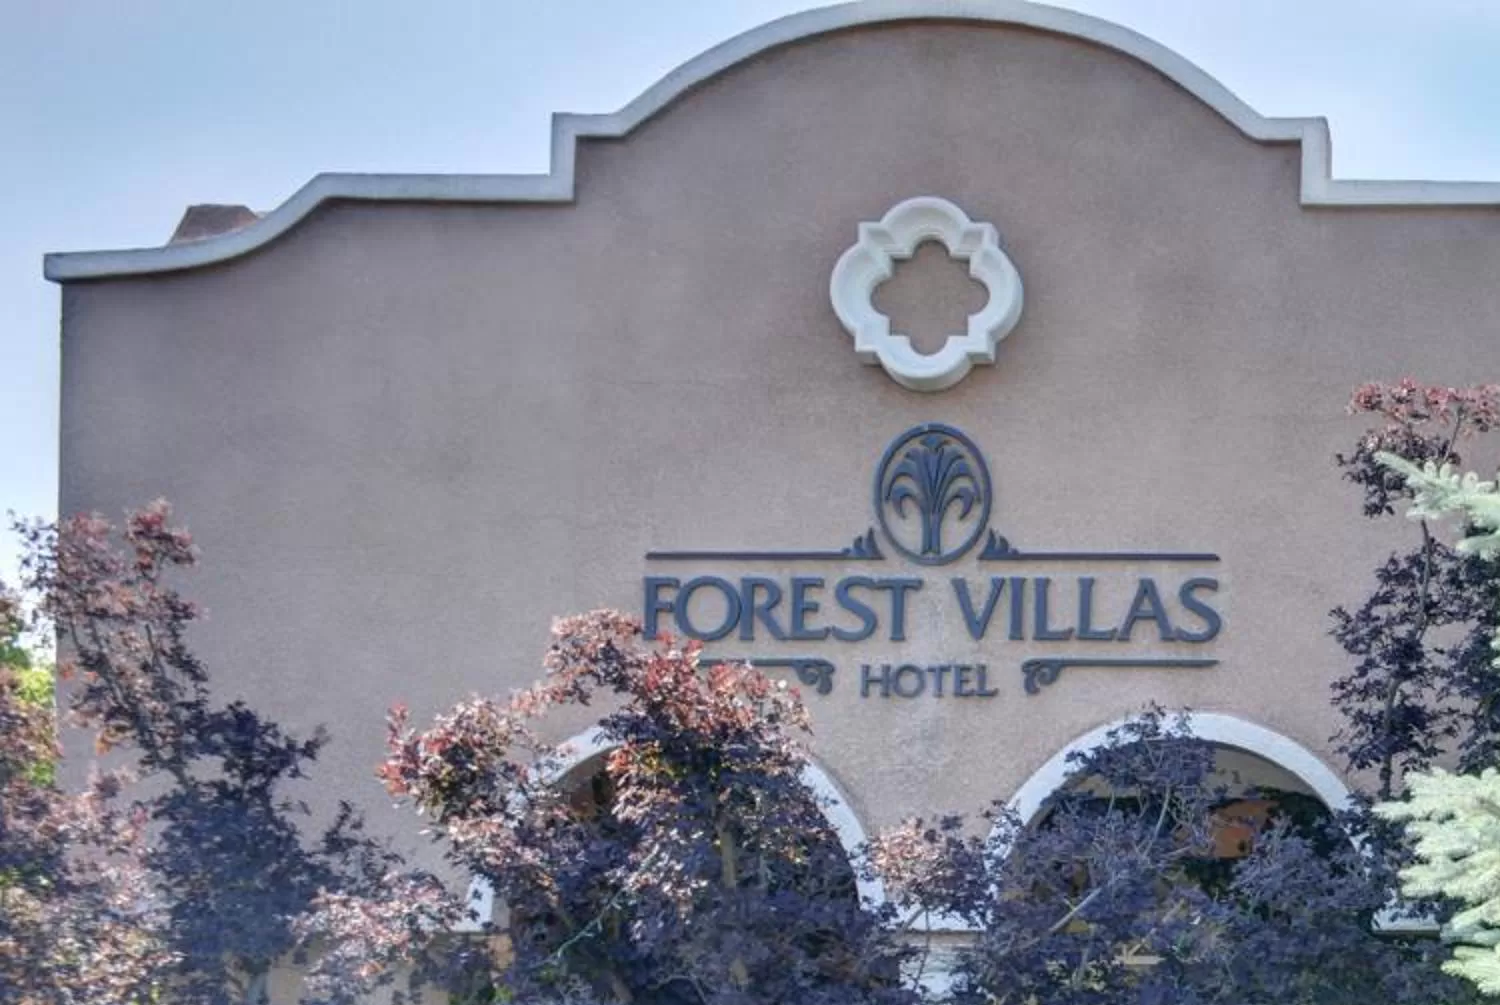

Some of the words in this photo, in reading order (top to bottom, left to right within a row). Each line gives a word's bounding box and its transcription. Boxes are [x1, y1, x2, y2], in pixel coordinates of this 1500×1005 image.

[642, 575, 923, 642] FOREST
[951, 576, 1222, 642] VILLAS
[860, 663, 998, 698] HOTEL
